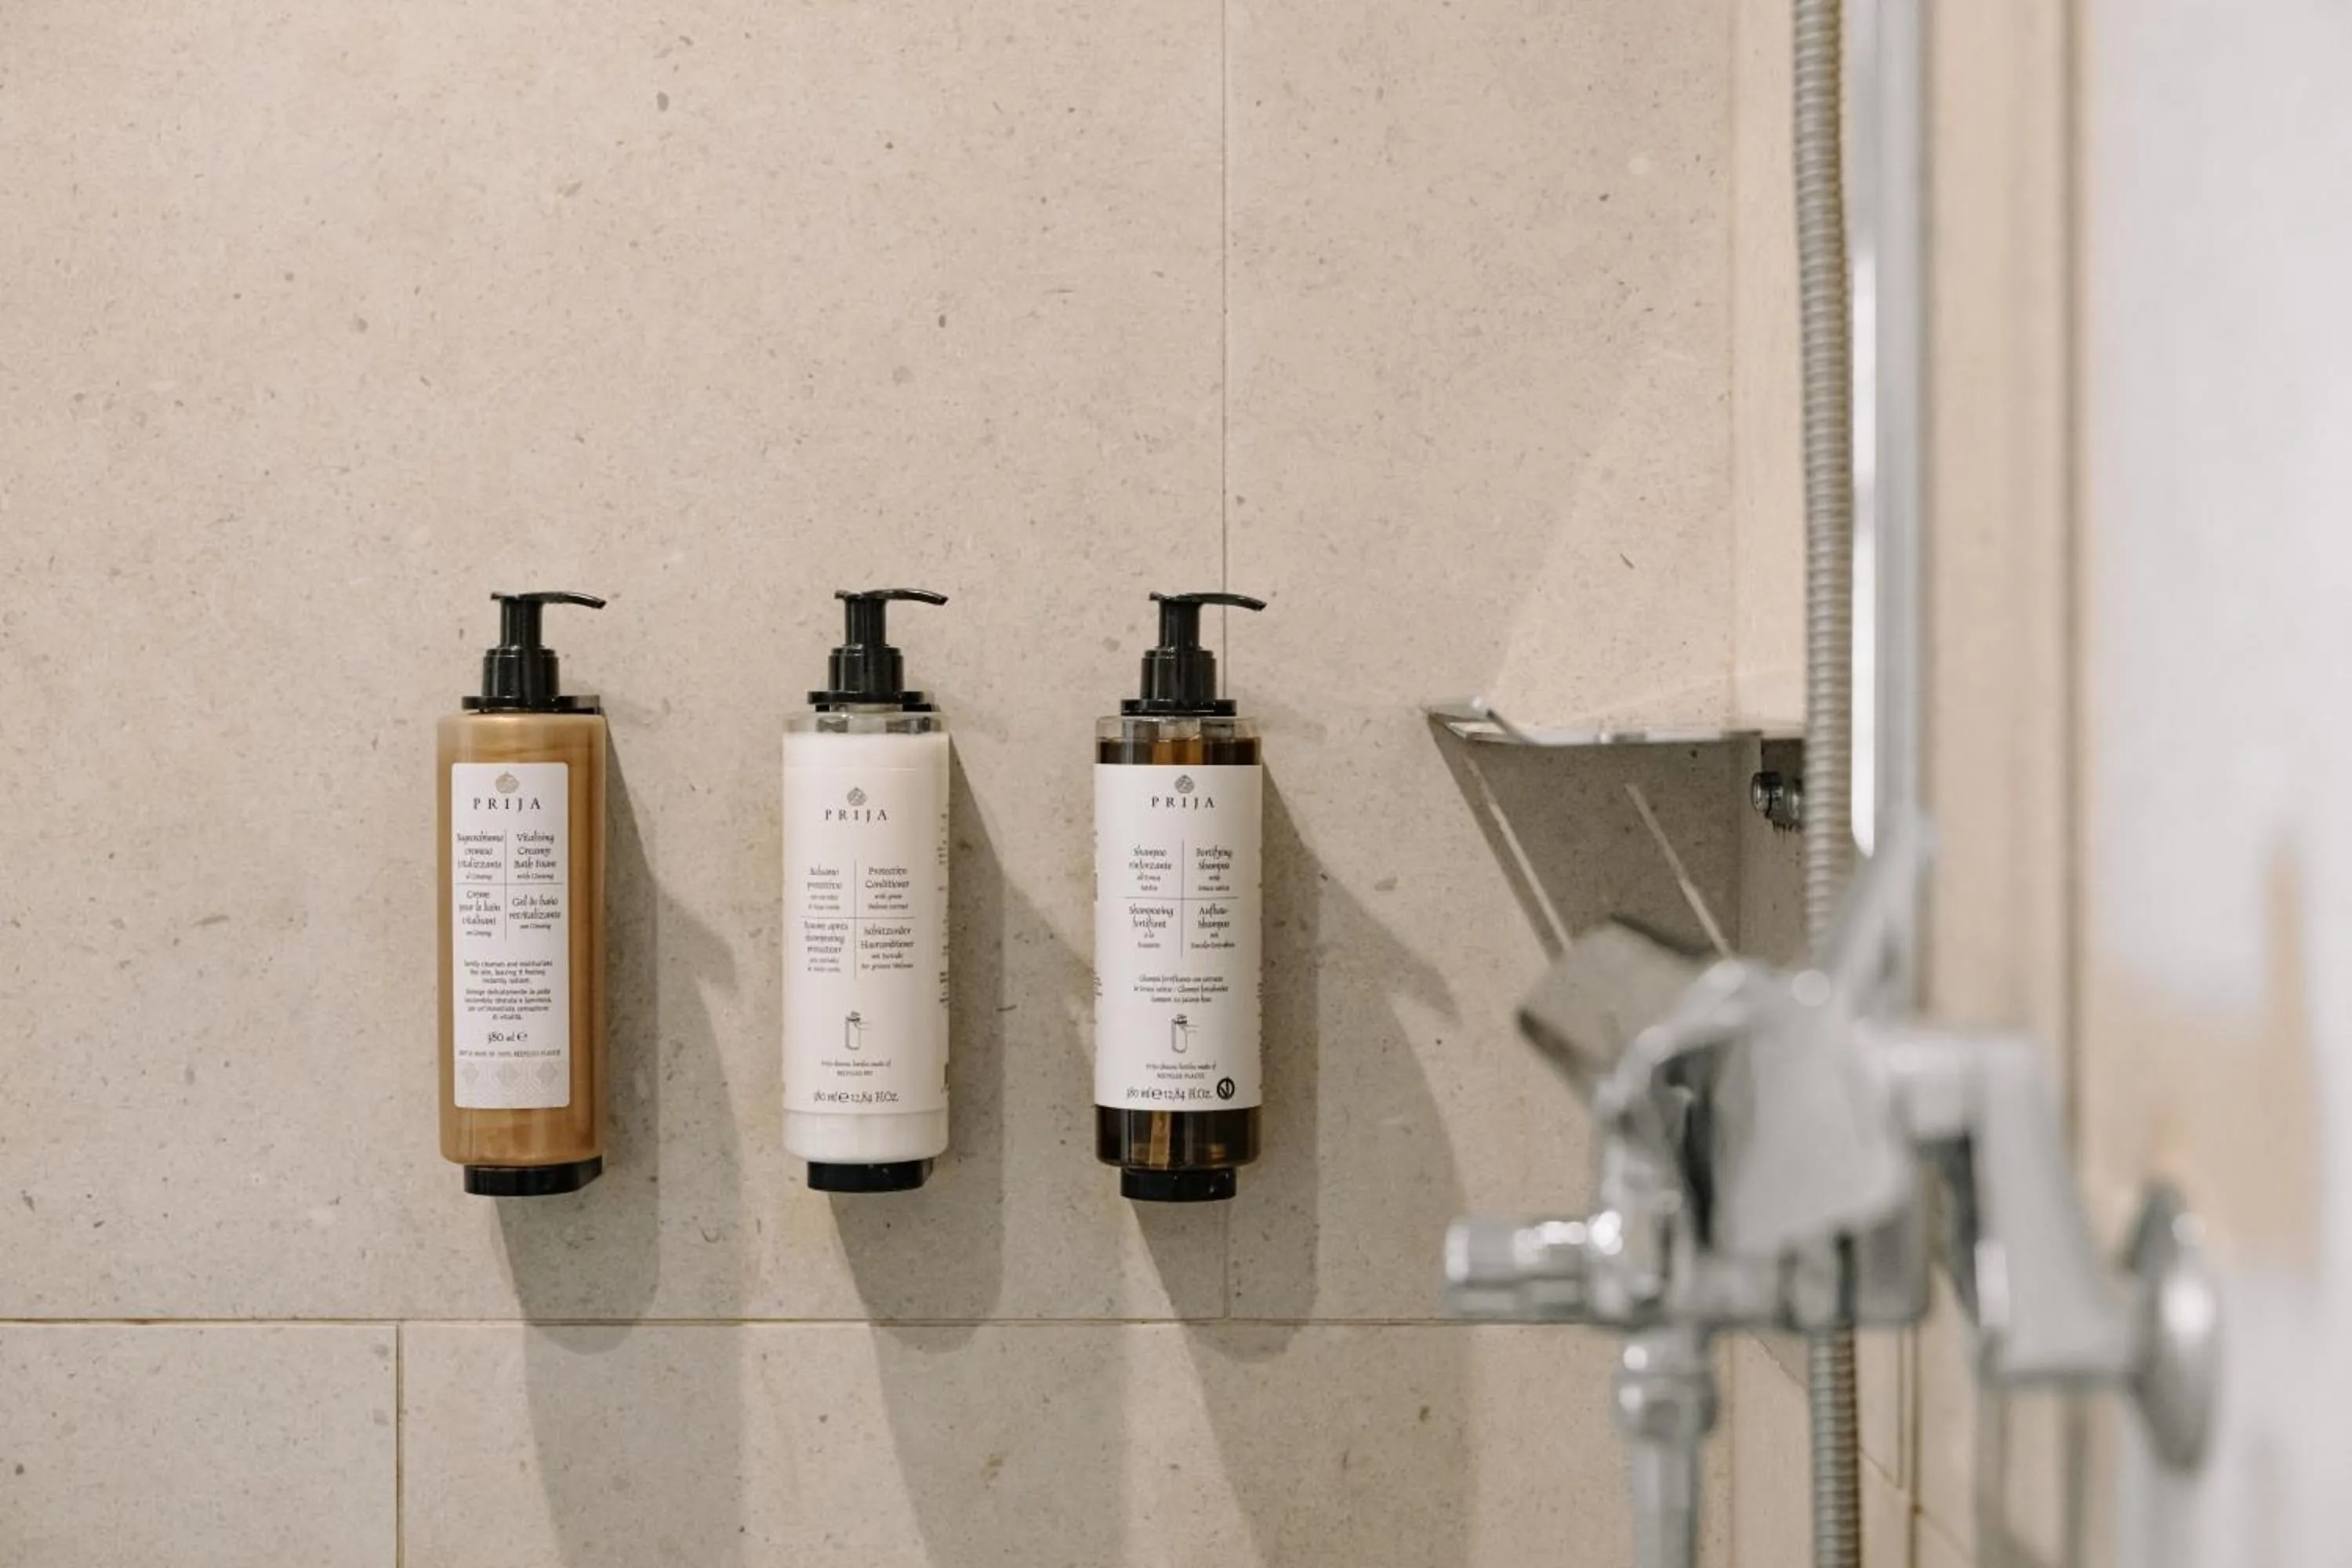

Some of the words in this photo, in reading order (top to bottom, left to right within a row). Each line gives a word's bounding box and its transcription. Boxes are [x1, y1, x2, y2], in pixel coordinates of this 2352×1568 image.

[473, 797, 541, 811] PRIJA
[1151, 797, 1215, 810] PRIJA
[826, 809, 887, 822] PRIJA
[512, 894, 528, 906] Gel
[488, 1031, 504, 1044] 380
